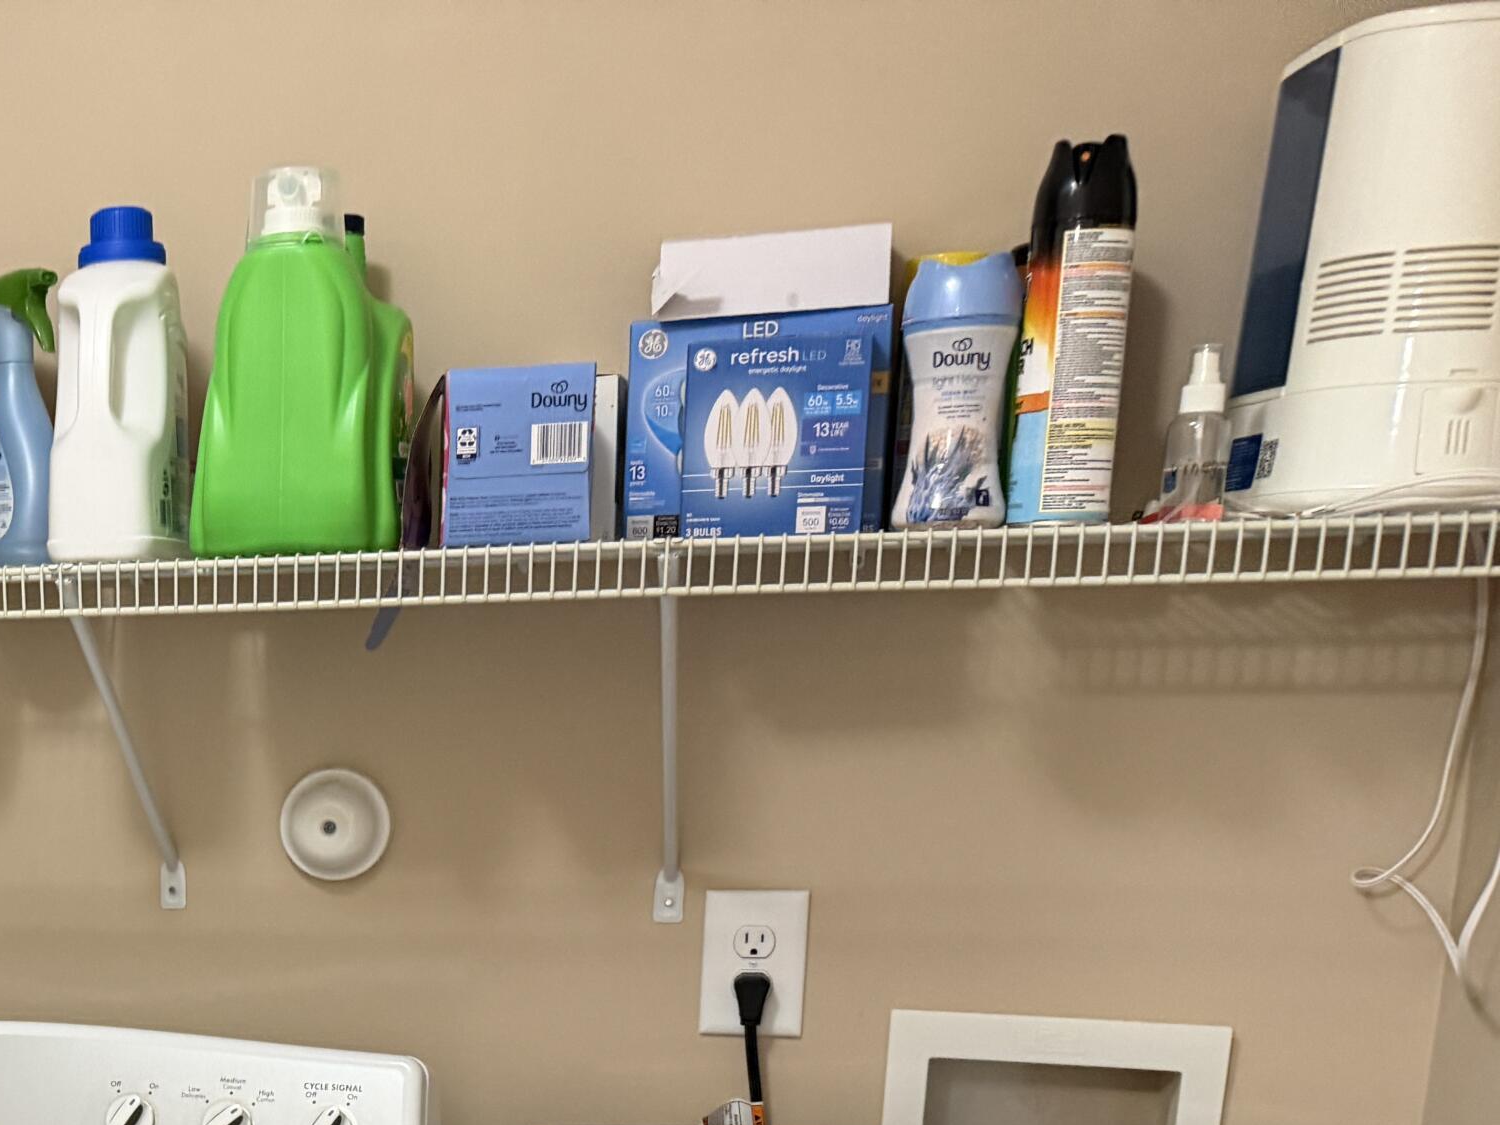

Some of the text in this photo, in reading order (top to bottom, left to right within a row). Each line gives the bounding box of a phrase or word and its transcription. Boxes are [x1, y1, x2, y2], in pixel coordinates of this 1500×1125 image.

[742, 320, 779, 339] LED
[730, 347, 800, 366] refresh
[802, 351, 827, 361] LED
[932, 350, 991, 371] Downy
[748, 365, 807, 375] energetic daylight
[531, 392, 588, 412] Downy
[813, 421, 830, 437] 13
[629, 466, 646, 480] 13
[810, 474, 845, 484] Daylight
[686, 527, 722, 537] 3 BULBS
[258, 1090, 274, 1098] High
[304, 1082, 363, 1093] CYCLE SIGNAL
